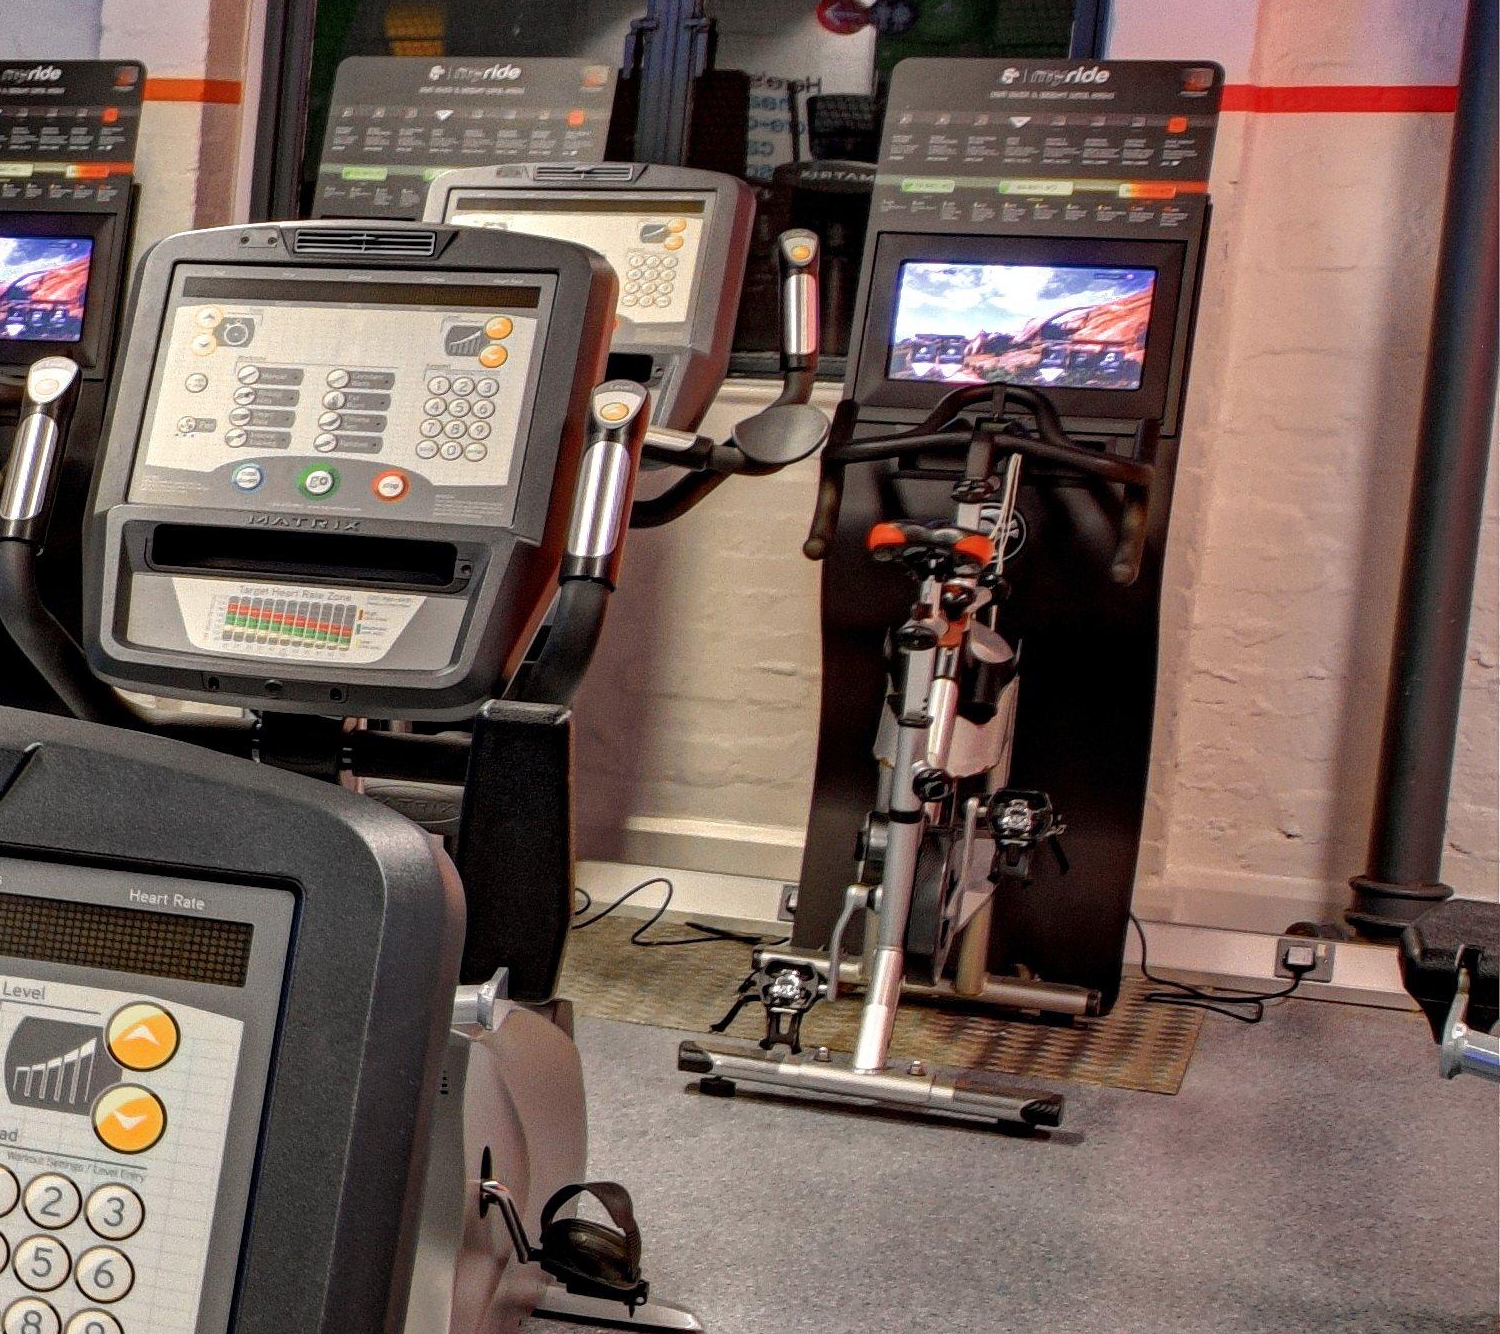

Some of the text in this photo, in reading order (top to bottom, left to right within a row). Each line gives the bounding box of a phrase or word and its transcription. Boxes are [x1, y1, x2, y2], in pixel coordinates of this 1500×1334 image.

[248, 515, 361, 532] MATRIX
[129, 888, 170, 908] Heart
[173, 893, 206, 912] Rate
[2, 980, 47, 1001] Level
[40, 1186, 62, 1217] 2
[102, 1197, 125, 1227] 3
[31, 1246, 53, 1277] 5
[93, 1259, 114, 1288] 6
